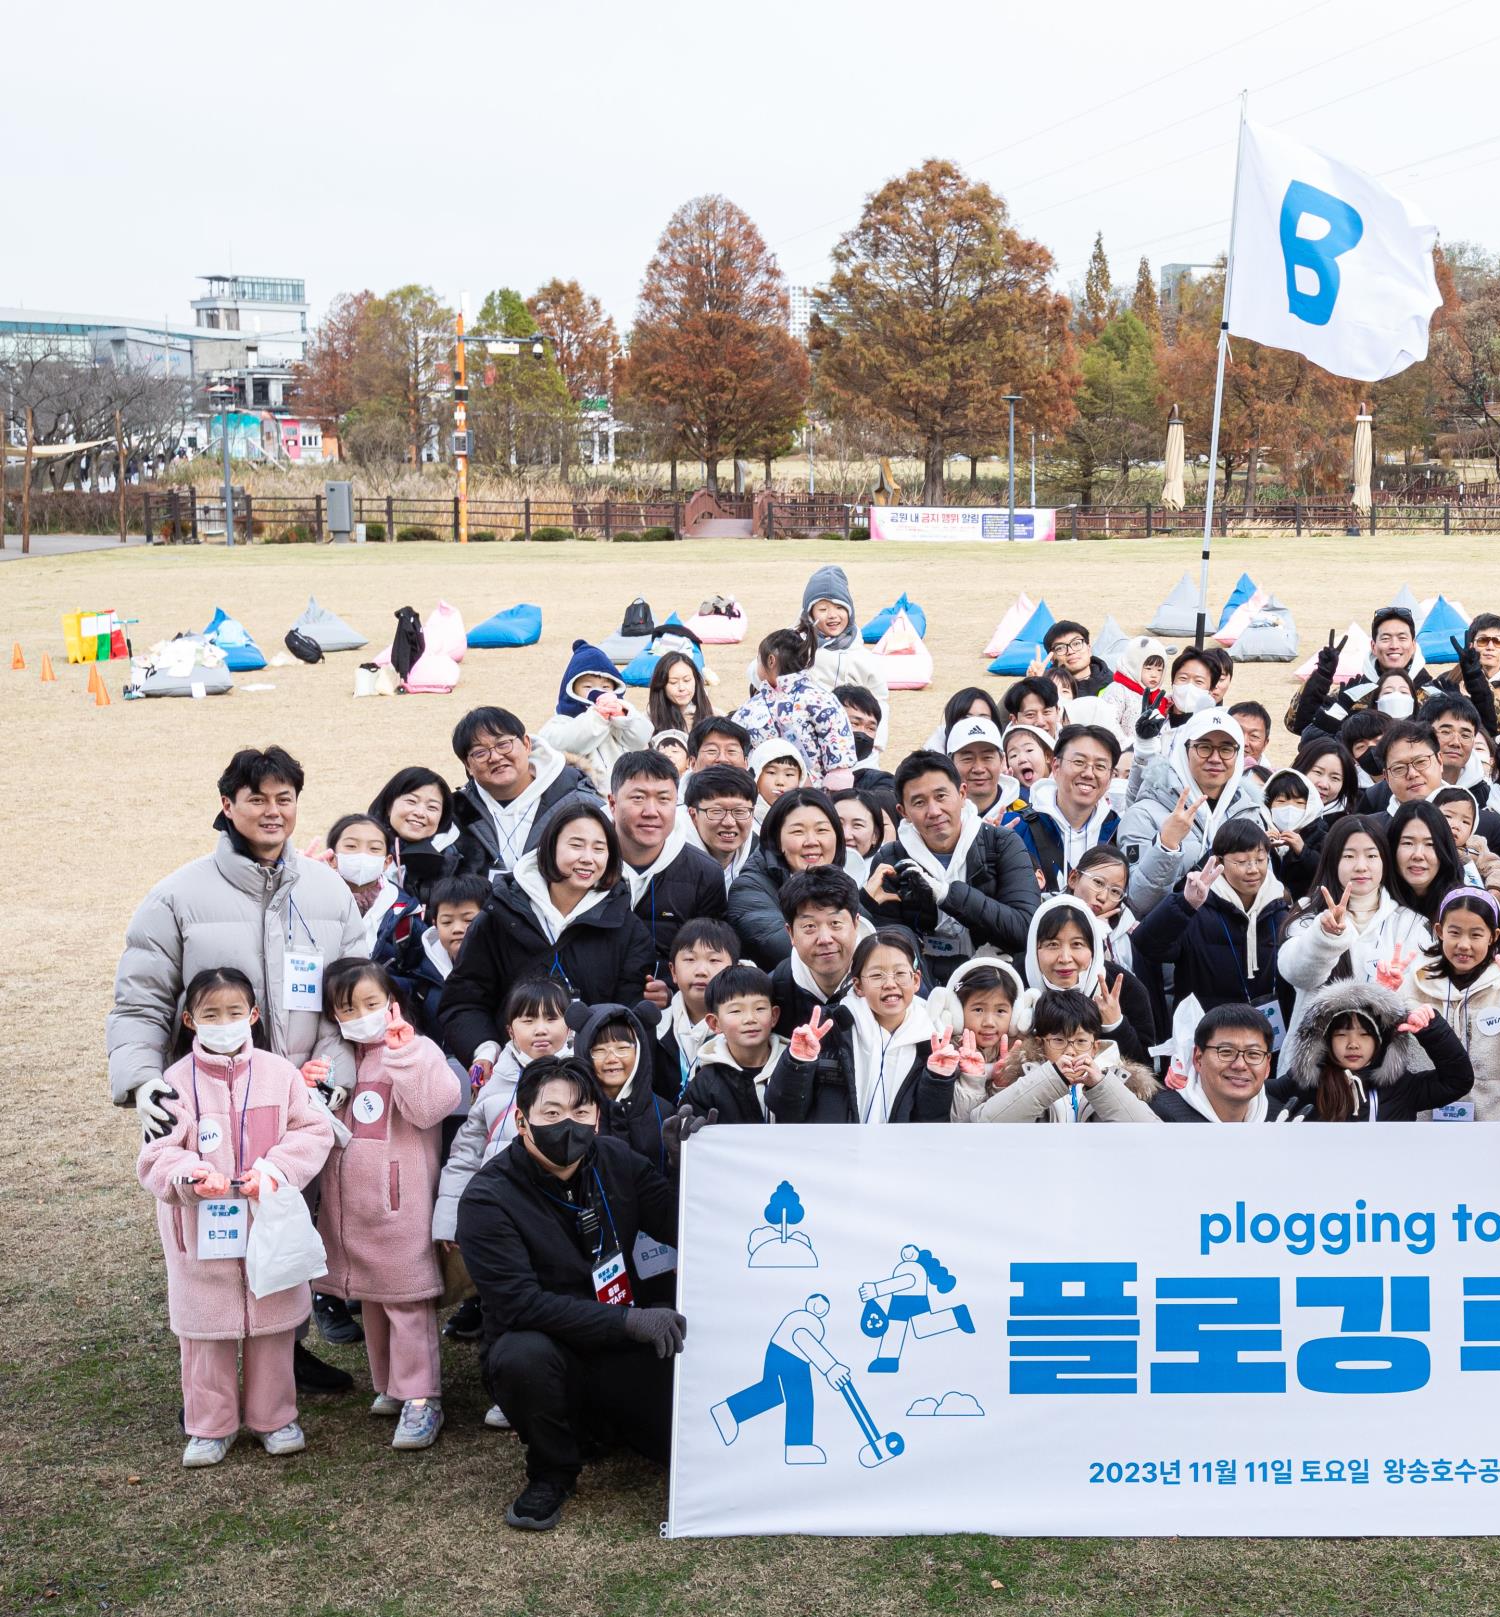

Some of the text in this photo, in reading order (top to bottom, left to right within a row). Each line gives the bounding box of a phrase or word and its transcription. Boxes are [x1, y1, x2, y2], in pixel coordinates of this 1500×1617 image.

[1280, 180, 1363, 325] B
[291, 983, 316, 993] B그룹
[200, 1131, 218, 1142] WIA
[208, 1229, 239, 1240] B그룹
[1200, 1199, 1436, 1255] plogging
[1006, 1261, 1432, 1395] 플로깅
[1089, 1459, 1181, 1486] 2023년
[1188, 1458, 1237, 1486] 11월
[1245, 1458, 1293, 1485] 11일
[1300, 1458, 1370, 1485] 토요일
